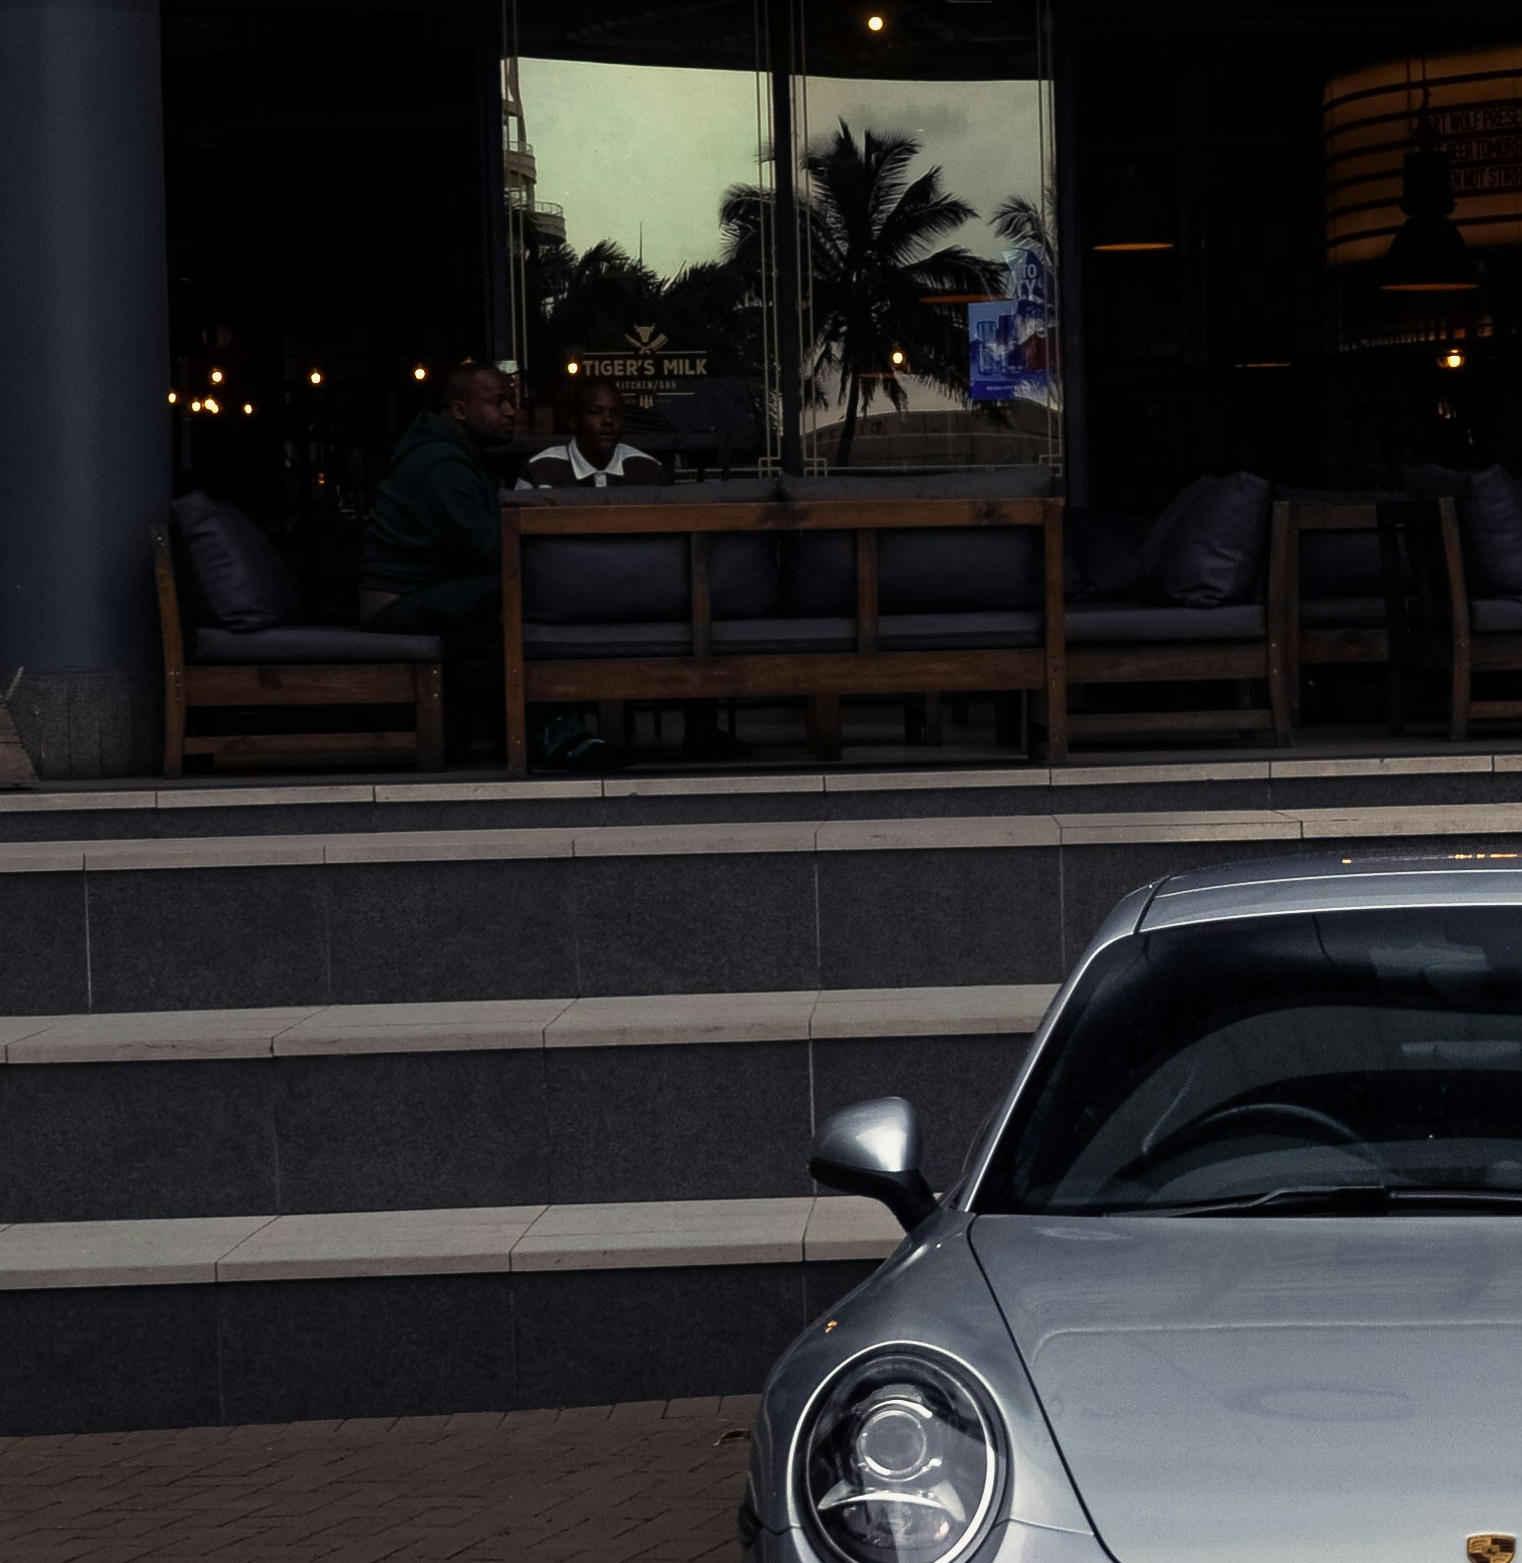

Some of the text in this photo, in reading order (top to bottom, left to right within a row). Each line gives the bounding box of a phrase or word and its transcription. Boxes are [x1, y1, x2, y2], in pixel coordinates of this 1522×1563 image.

[1463, 168, 1486, 188] NOT
[582, 357, 709, 377] TIGER'S MILK
